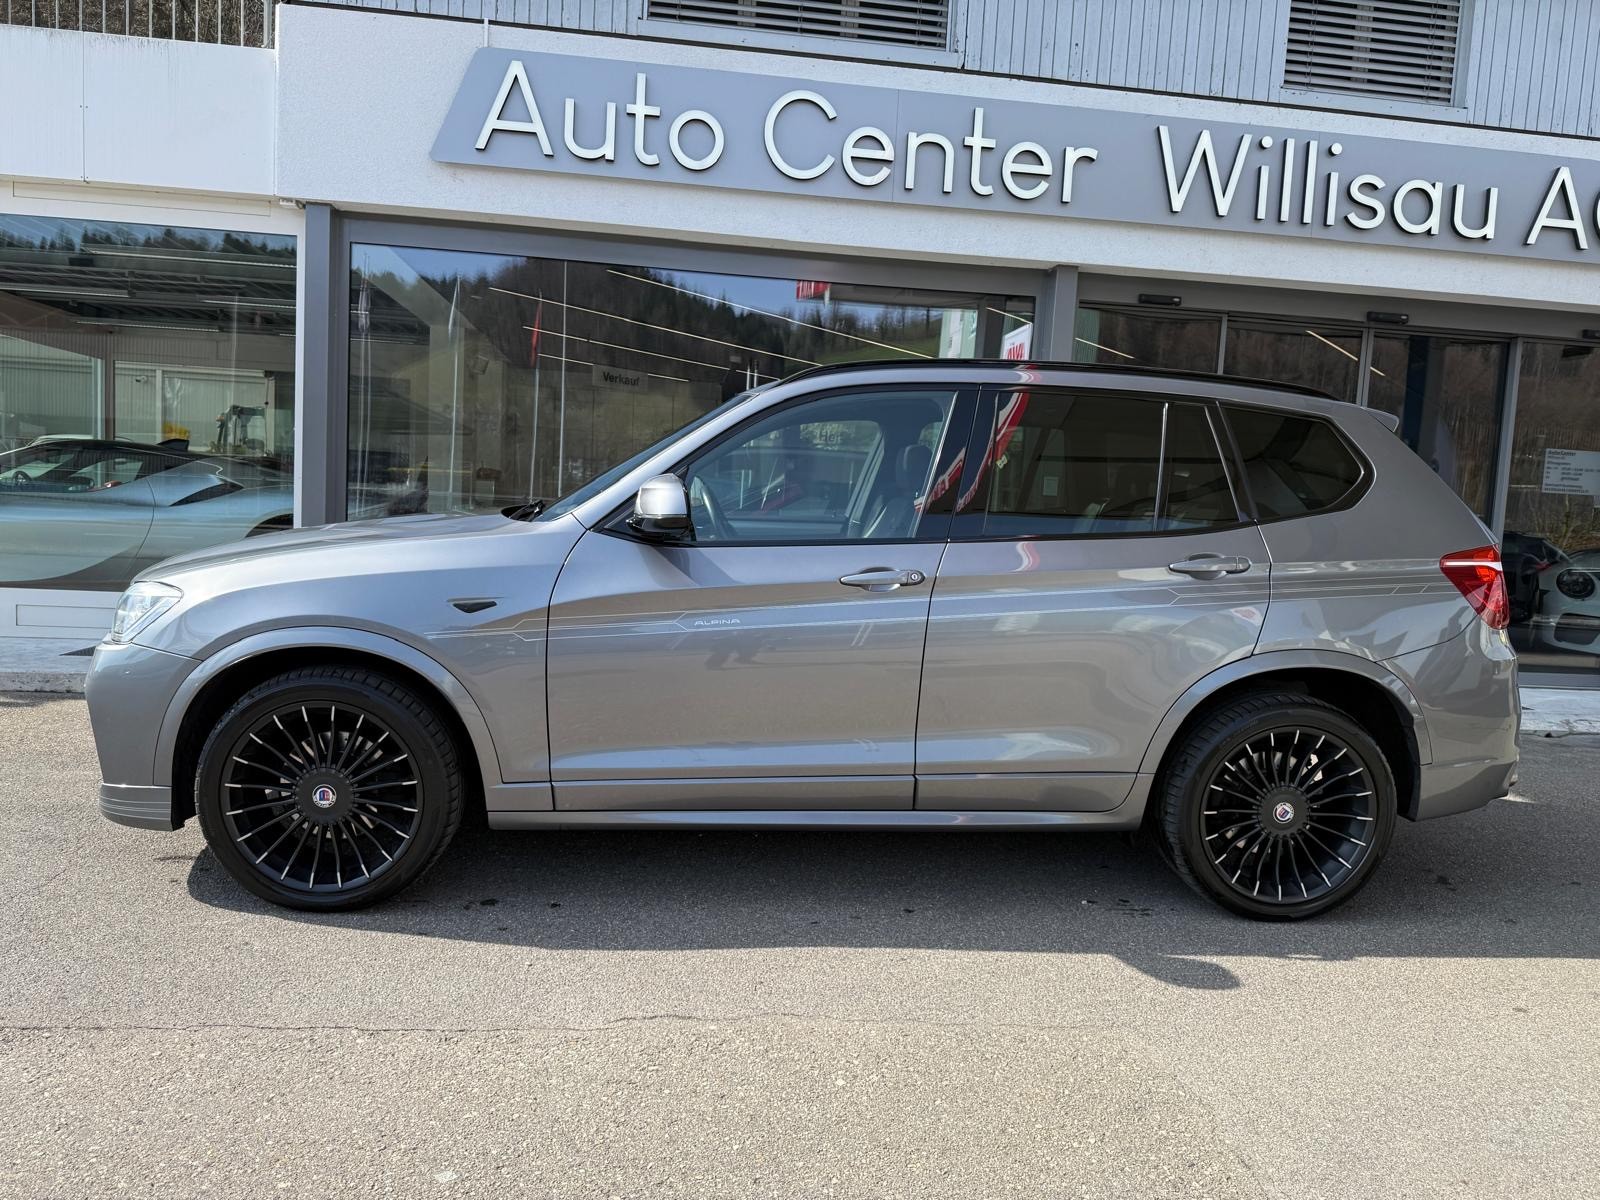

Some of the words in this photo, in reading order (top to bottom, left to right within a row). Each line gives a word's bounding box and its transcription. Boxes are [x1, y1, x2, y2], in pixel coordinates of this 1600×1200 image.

[475, 60, 724, 171] Auto
[764, 90, 1098, 203] Center
[1158, 125, 1498, 240] Willisau
[1524, 166, 1600, 250] A
[603, 371, 640, 386] Verkauf
[694, 618, 740, 626] ALPINA
